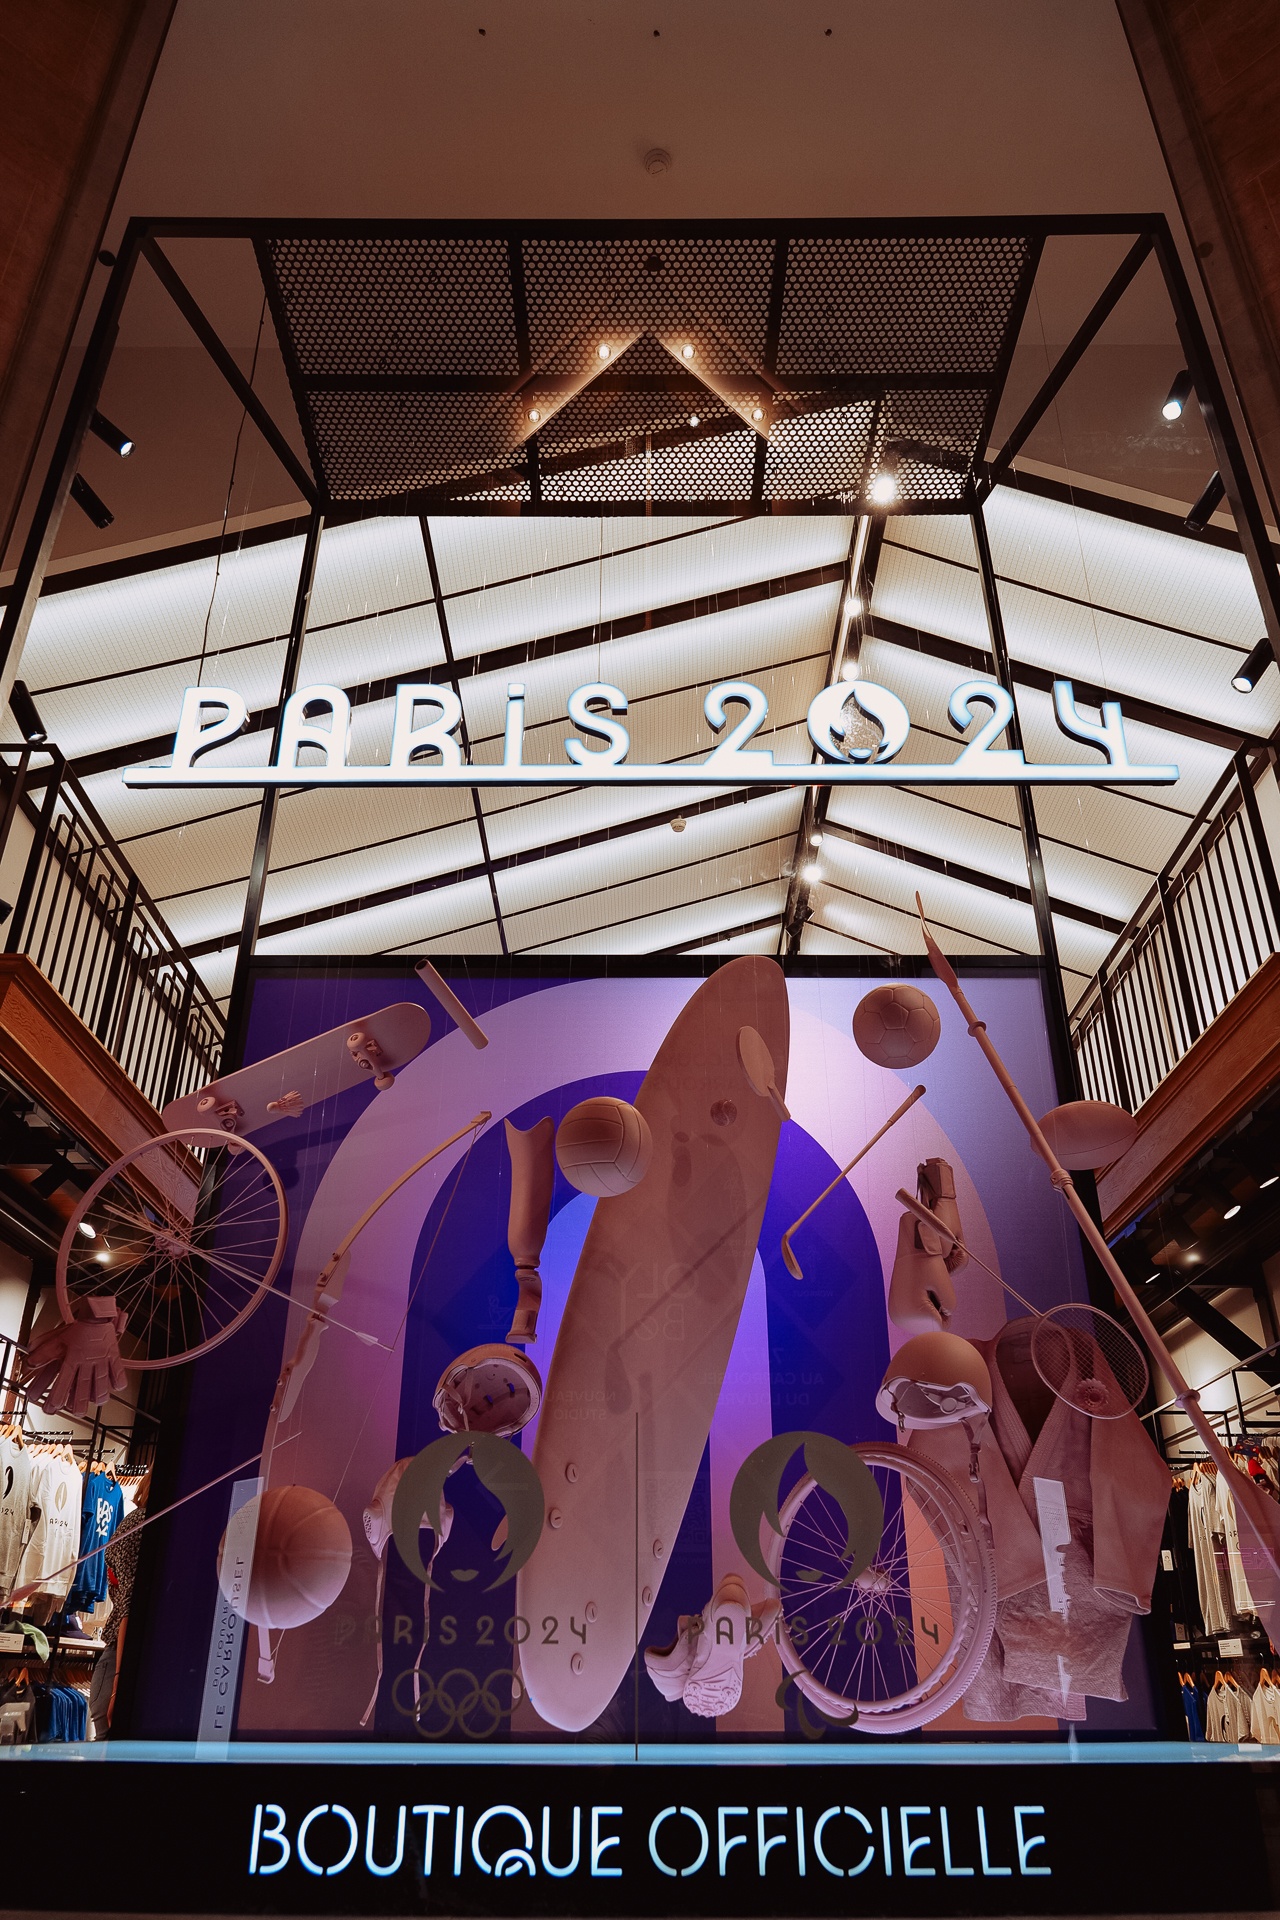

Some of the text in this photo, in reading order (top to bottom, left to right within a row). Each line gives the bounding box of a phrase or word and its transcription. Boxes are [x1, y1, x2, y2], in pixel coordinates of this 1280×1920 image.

[704, 680, 1131, 767] 2024
[476, 1615, 588, 1646] 2024
[827, 1616, 940, 1646] 2024
[248, 1803, 1053, 1877] BOUTIQUE OFFICIELLE
